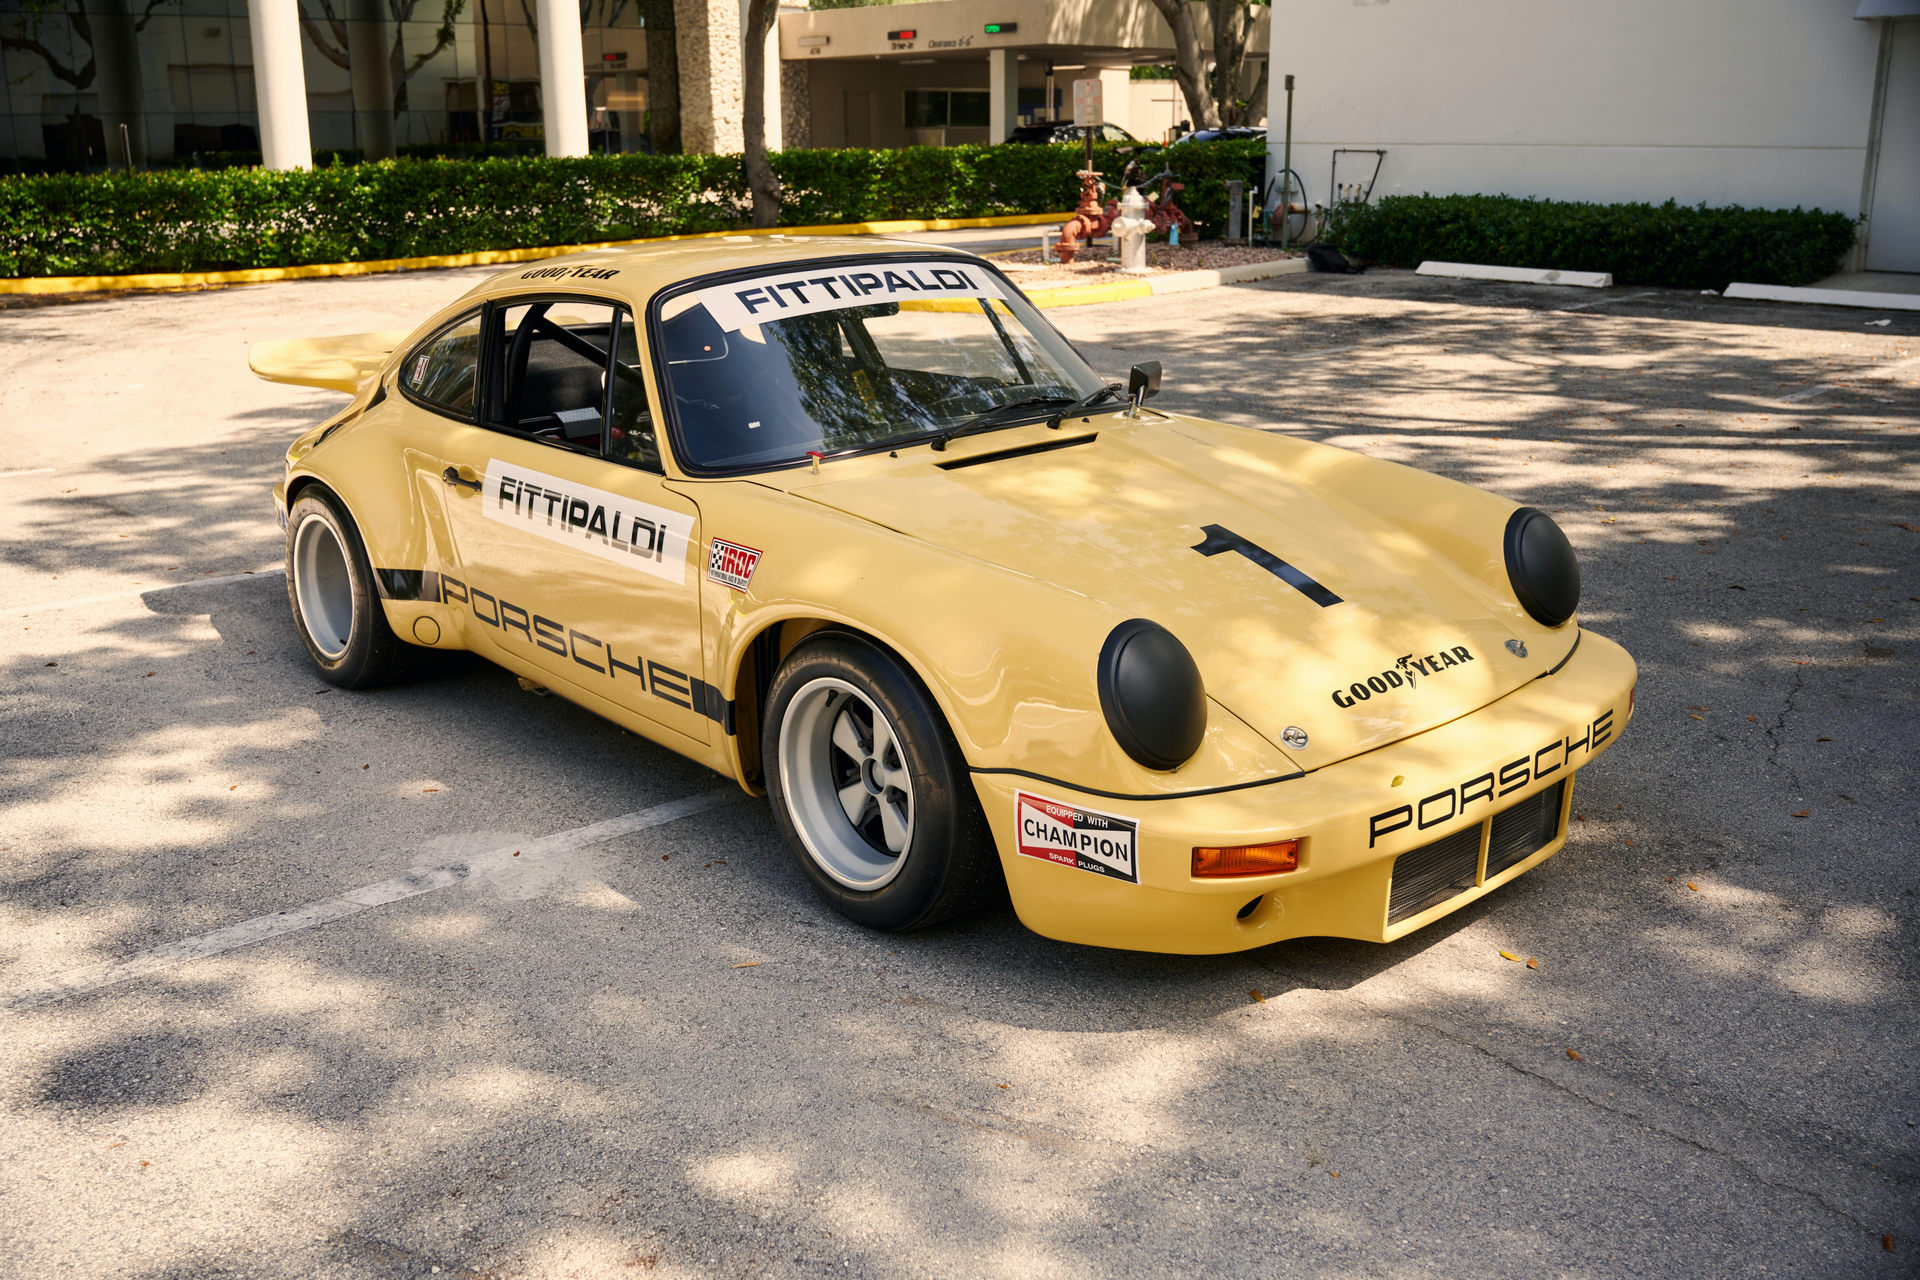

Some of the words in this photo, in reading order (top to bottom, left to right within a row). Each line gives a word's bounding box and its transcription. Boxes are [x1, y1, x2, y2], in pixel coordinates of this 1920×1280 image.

[985, 24, 1000, 33] OPEN
[734, 269, 980, 315] FITTIPALDI
[498, 475, 667, 563] FITTIPALDI
[721, 546, 757, 579] IROC
[440, 573, 692, 710] PORSCHE
[1368, 708, 1614, 849] PORSCHE
[1046, 804, 1084, 823] EQUIPPED
[1087, 815, 1109, 829] WITH
[1023, 818, 1129, 862] CHAMPION
[1048, 852, 1076, 866] SPARK
[1077, 860, 1106, 874] PLUGS
